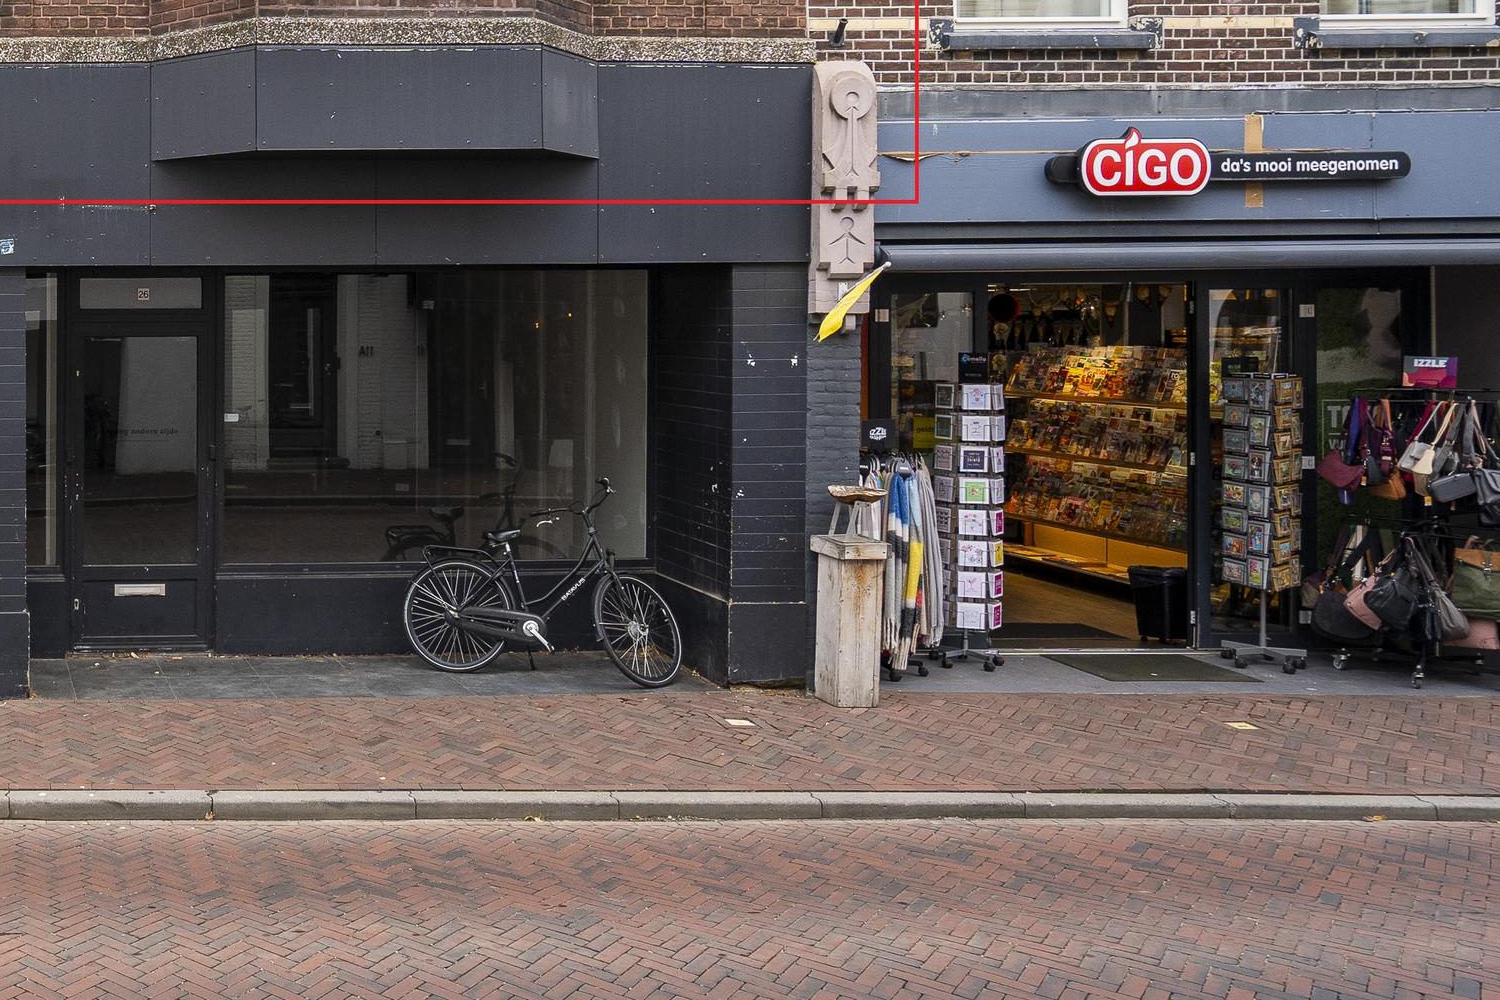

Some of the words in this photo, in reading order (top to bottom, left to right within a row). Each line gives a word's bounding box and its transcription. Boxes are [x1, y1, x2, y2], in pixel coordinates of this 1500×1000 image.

[1220, 158, 1251, 173] da's
[1255, 158, 1292, 172] mooi
[1296, 158, 1399, 175] meegenomen
[1413, 358, 1447, 368] IZZLE
